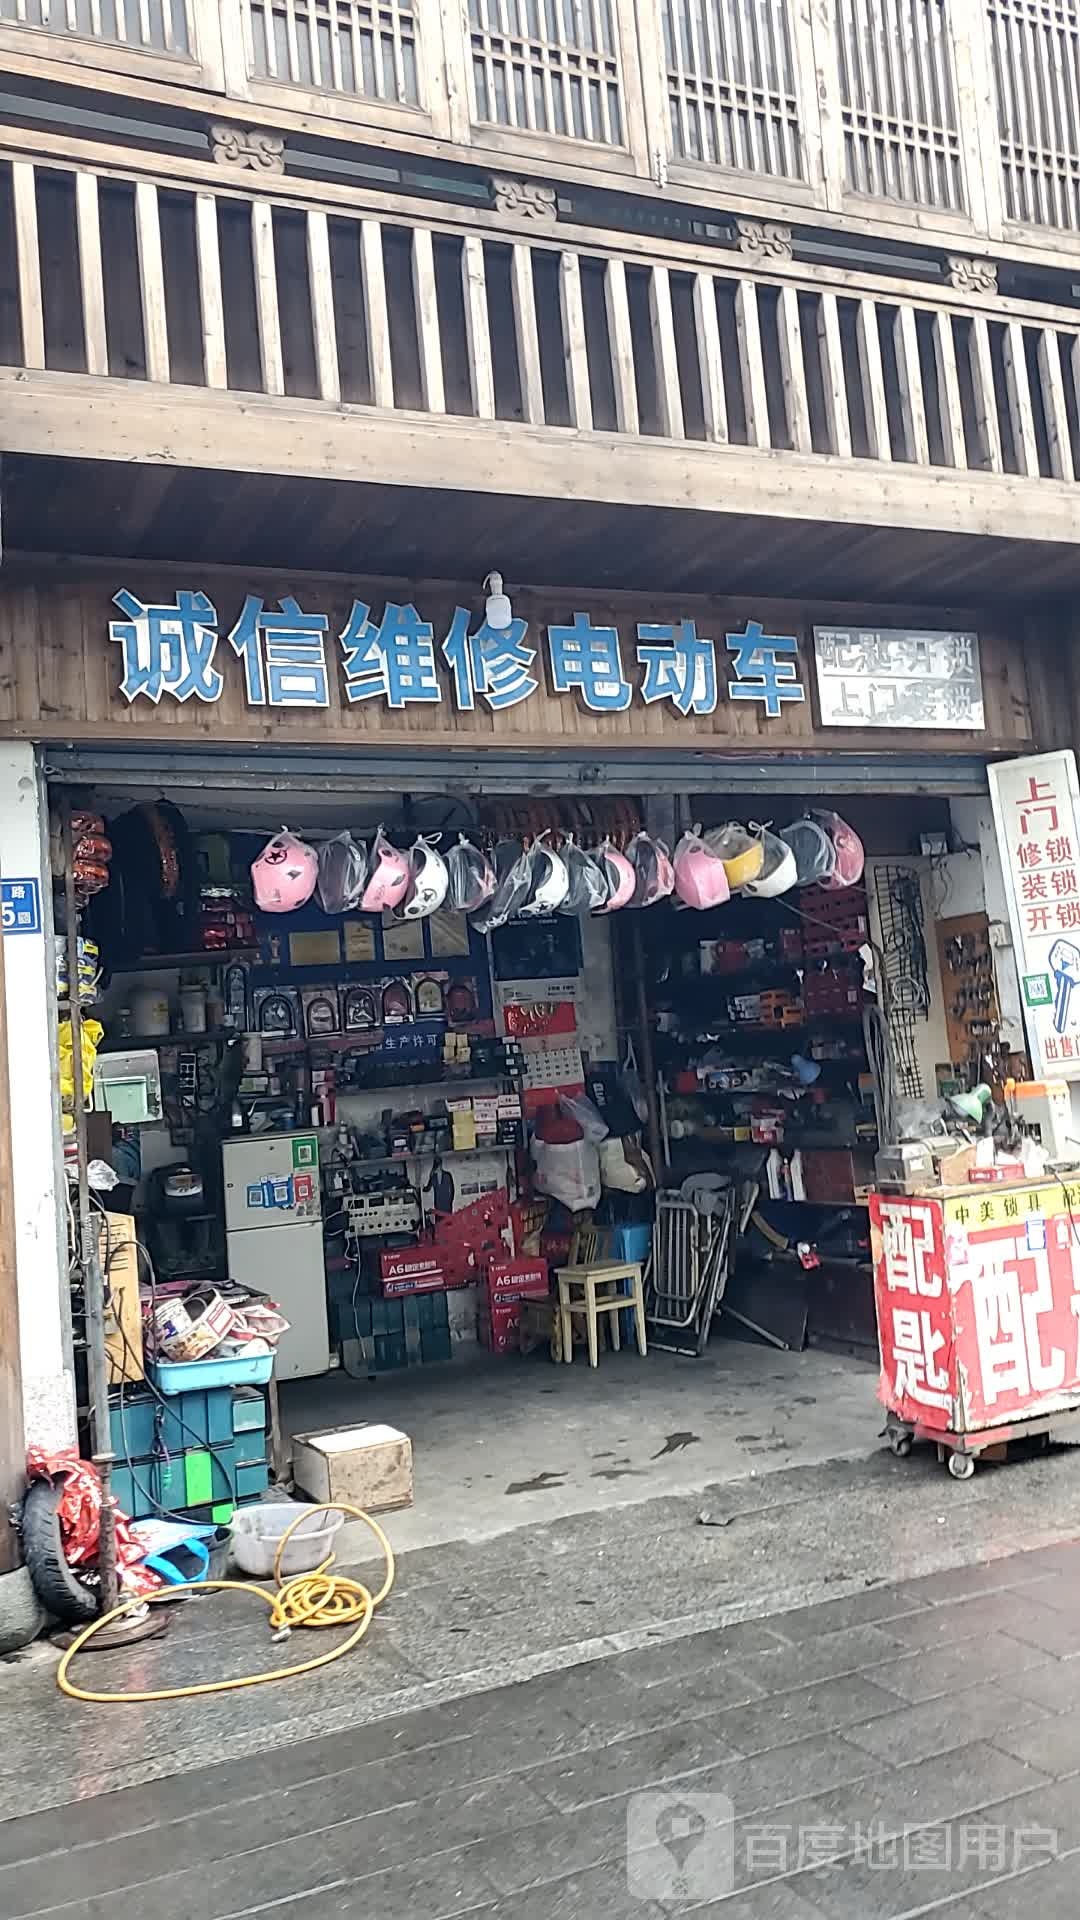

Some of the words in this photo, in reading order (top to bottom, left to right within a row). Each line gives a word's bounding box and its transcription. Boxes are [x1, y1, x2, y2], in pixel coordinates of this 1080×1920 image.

[108, 588, 805, 718] 诚信维修电动车
[831, 680, 974, 722] 上门锁
[1016, 776, 1058, 834] 上门
[1017, 835, 1073, 869] 修锁
[1021, 868, 1079, 900] 装锁
[1027, 901, 1080, 932] 开锁
[385, 1033, 438, 1050] 生产许可
[955, 1192, 1041, 1225] 中美锁具
[879, 1203, 953, 1410] 配匙
[966, 1224, 1080, 1406] 配
